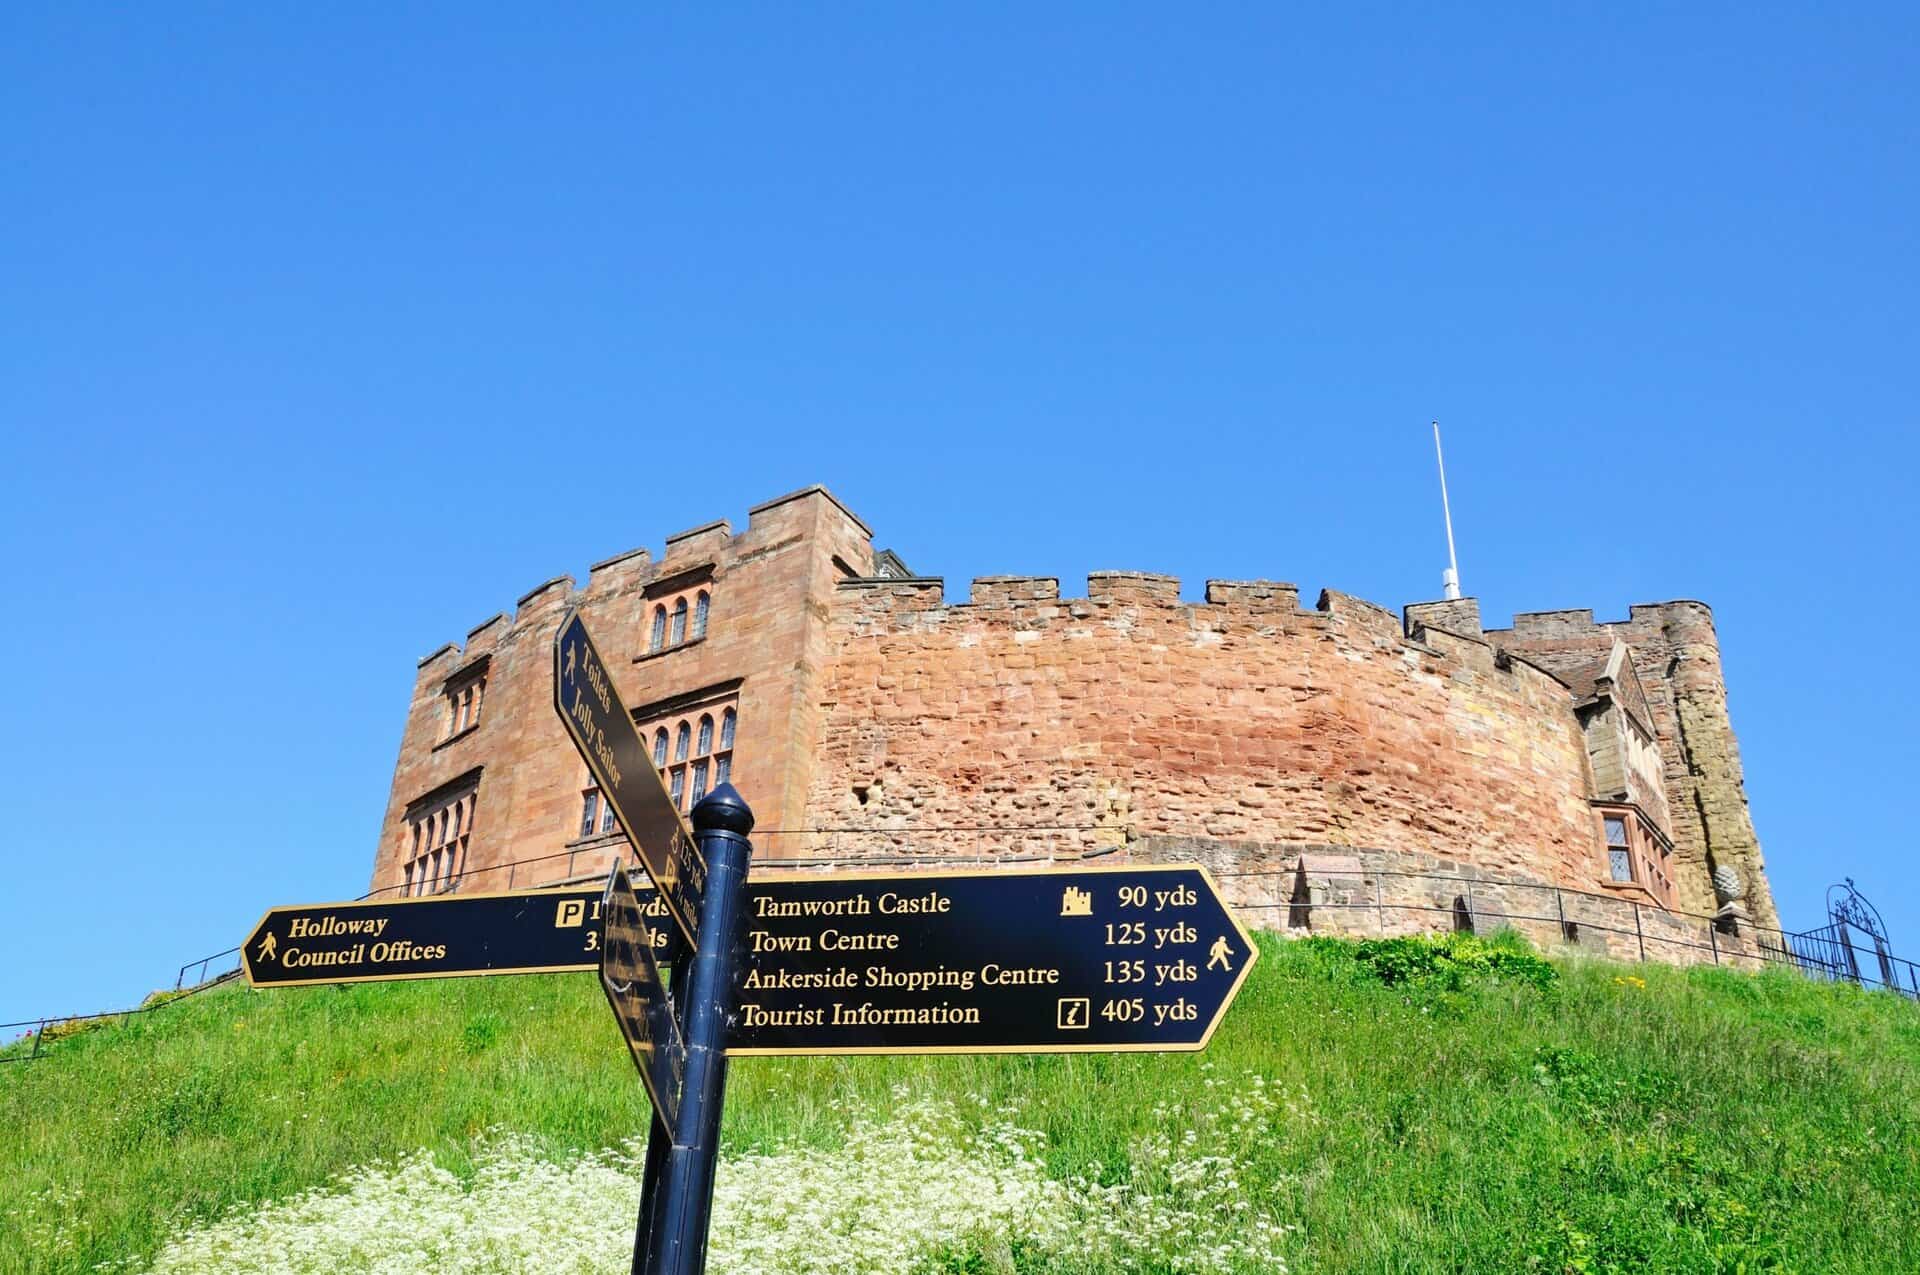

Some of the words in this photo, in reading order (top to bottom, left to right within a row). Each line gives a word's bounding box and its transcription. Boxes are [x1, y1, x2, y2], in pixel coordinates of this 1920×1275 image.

[583, 642, 611, 714] Toilets
[572, 687, 596, 744] Jolly
[595, 729, 621, 789] Sailor
[754, 894, 870, 917] Tamworth
[878, 892, 951, 914] Castle
[1118, 887, 1147, 907] 90
[1154, 885, 1197, 911] yds
[289, 917, 388, 938] Holloway
[750, 931, 811, 952] Town
[819, 930, 899, 951] Centre
[1104, 923, 1146, 945] 125
[1154, 922, 1197, 948] yds
[282, 943, 364, 968] Council
[370, 940, 446, 963] Offices
[647, 927, 668, 947] ds
[744, 967, 858, 990] Ankerside
[865, 965, 975, 992] Shopping
[981, 964, 1059, 985] Centre
[1104, 961, 1146, 983] 135
[1154, 960, 1197, 986] yds
[741, 1004, 824, 1027] Tourist
[831, 1002, 980, 1025] Information
[1101, 999, 1145, 1022] 405
[1154, 998, 1197, 1024] yds
